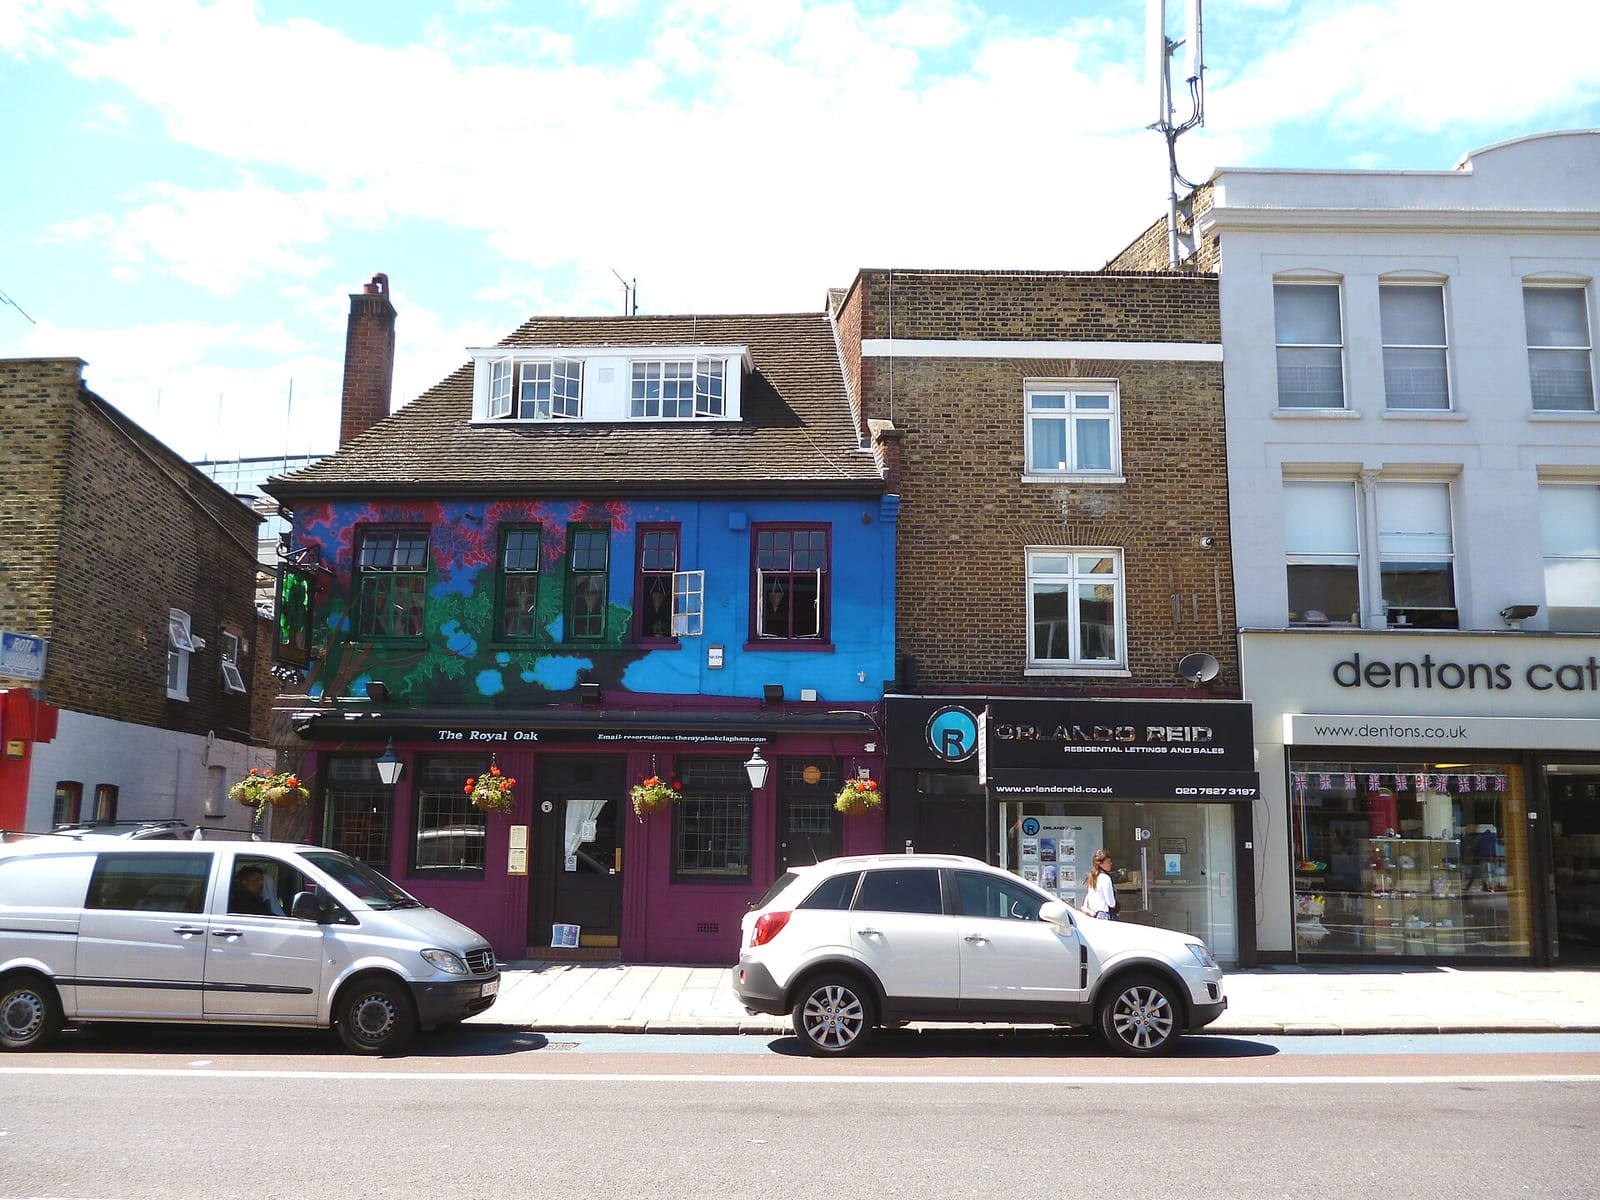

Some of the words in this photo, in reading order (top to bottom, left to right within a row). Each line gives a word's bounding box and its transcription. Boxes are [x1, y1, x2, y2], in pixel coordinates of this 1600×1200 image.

[13, 637, 34, 651] ROTI
[1333, 653, 1512, 690] dentons
[438, 730, 463, 740] The
[469, 730, 508, 742] Royal
[513, 731, 539, 741] Oak
[993, 724, 1136, 741] ORLANDO
[1146, 726, 1213, 742] REID
[1314, 724, 1467, 739] www.dentons.co.uk
[1125, 746, 1168, 754] LETTINGS
[1170, 747, 1191, 755] AND
[1193, 747, 1225, 755] SALES
[996, 785, 1113, 794] www.orlandoreid.co.uk
[1175, 787, 1198, 795] 020
[1199, 787, 1227, 795] 7627
